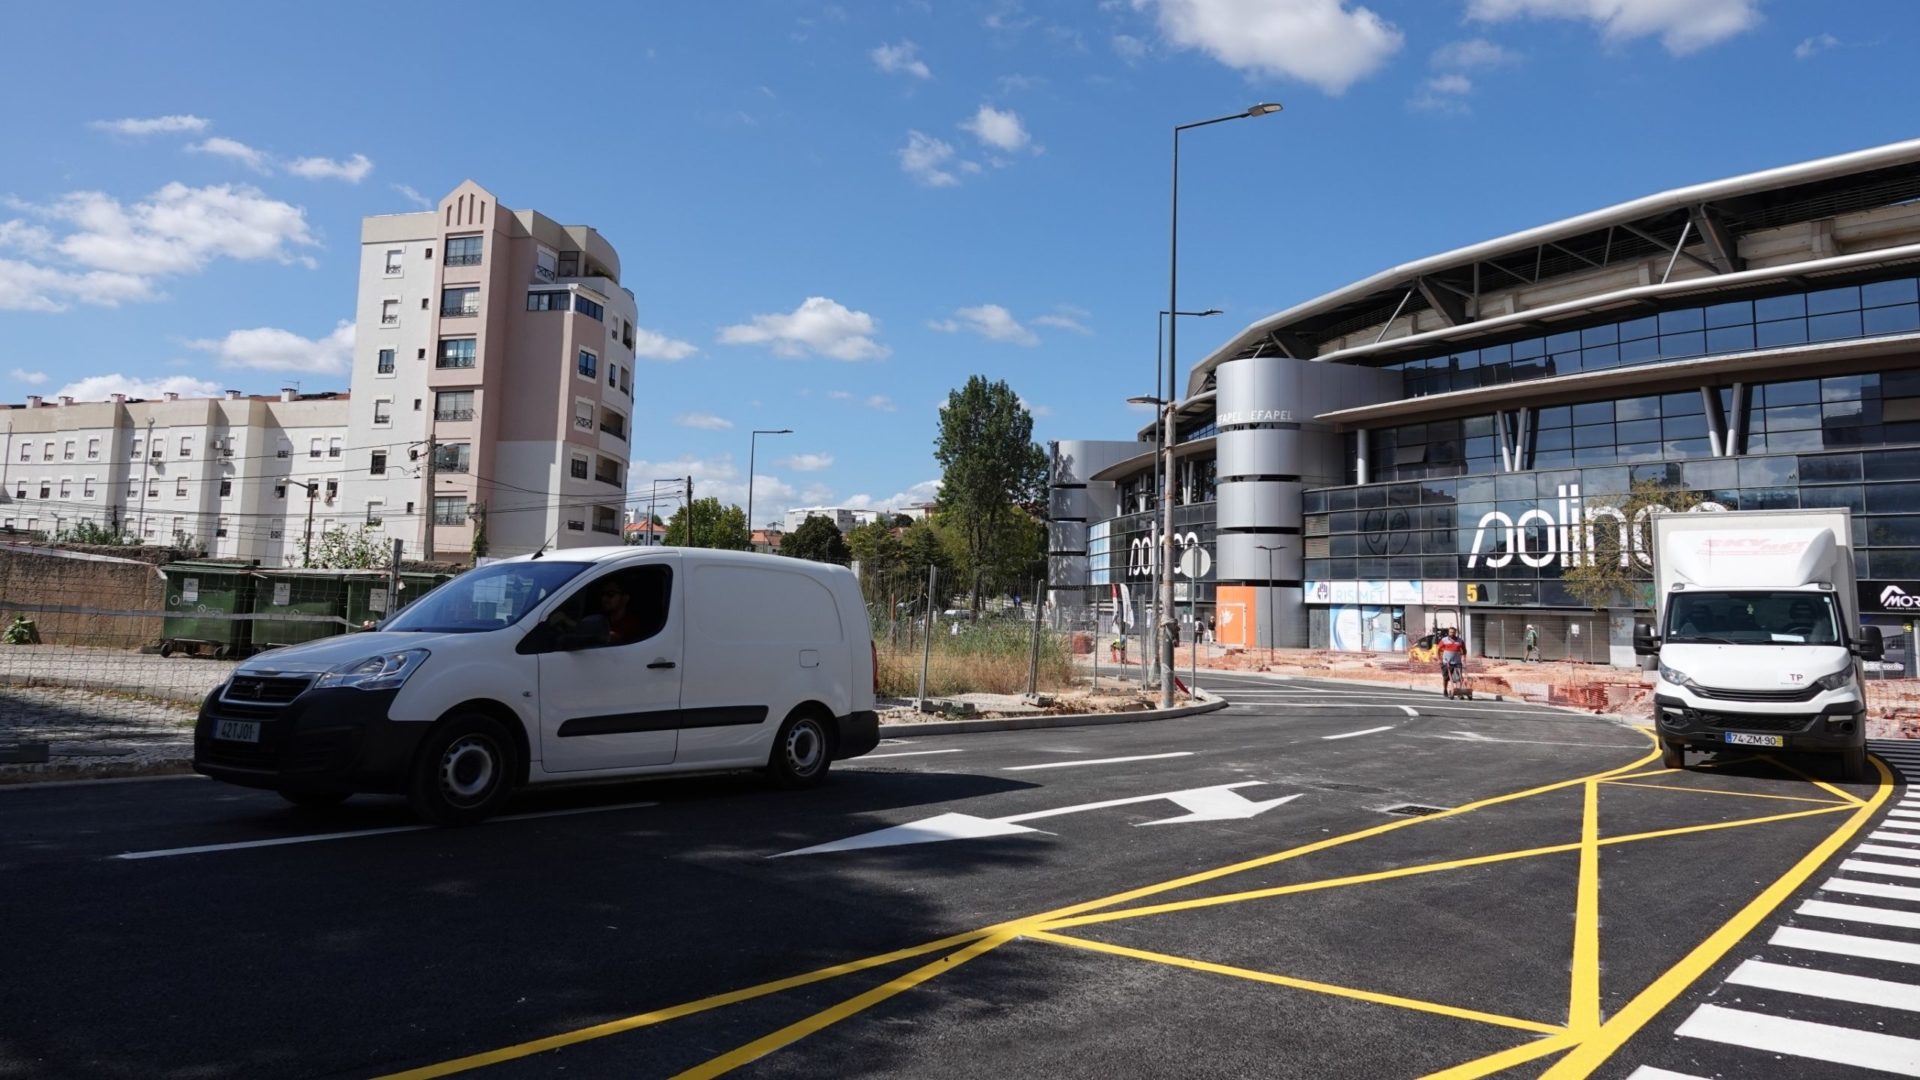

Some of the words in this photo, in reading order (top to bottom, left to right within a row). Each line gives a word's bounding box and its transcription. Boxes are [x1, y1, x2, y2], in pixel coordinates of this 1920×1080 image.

[1251, 410, 1293, 420] EFAPEL
[1467, 484, 1728, 569] solinc
[1789, 673, 1804, 681] TP
